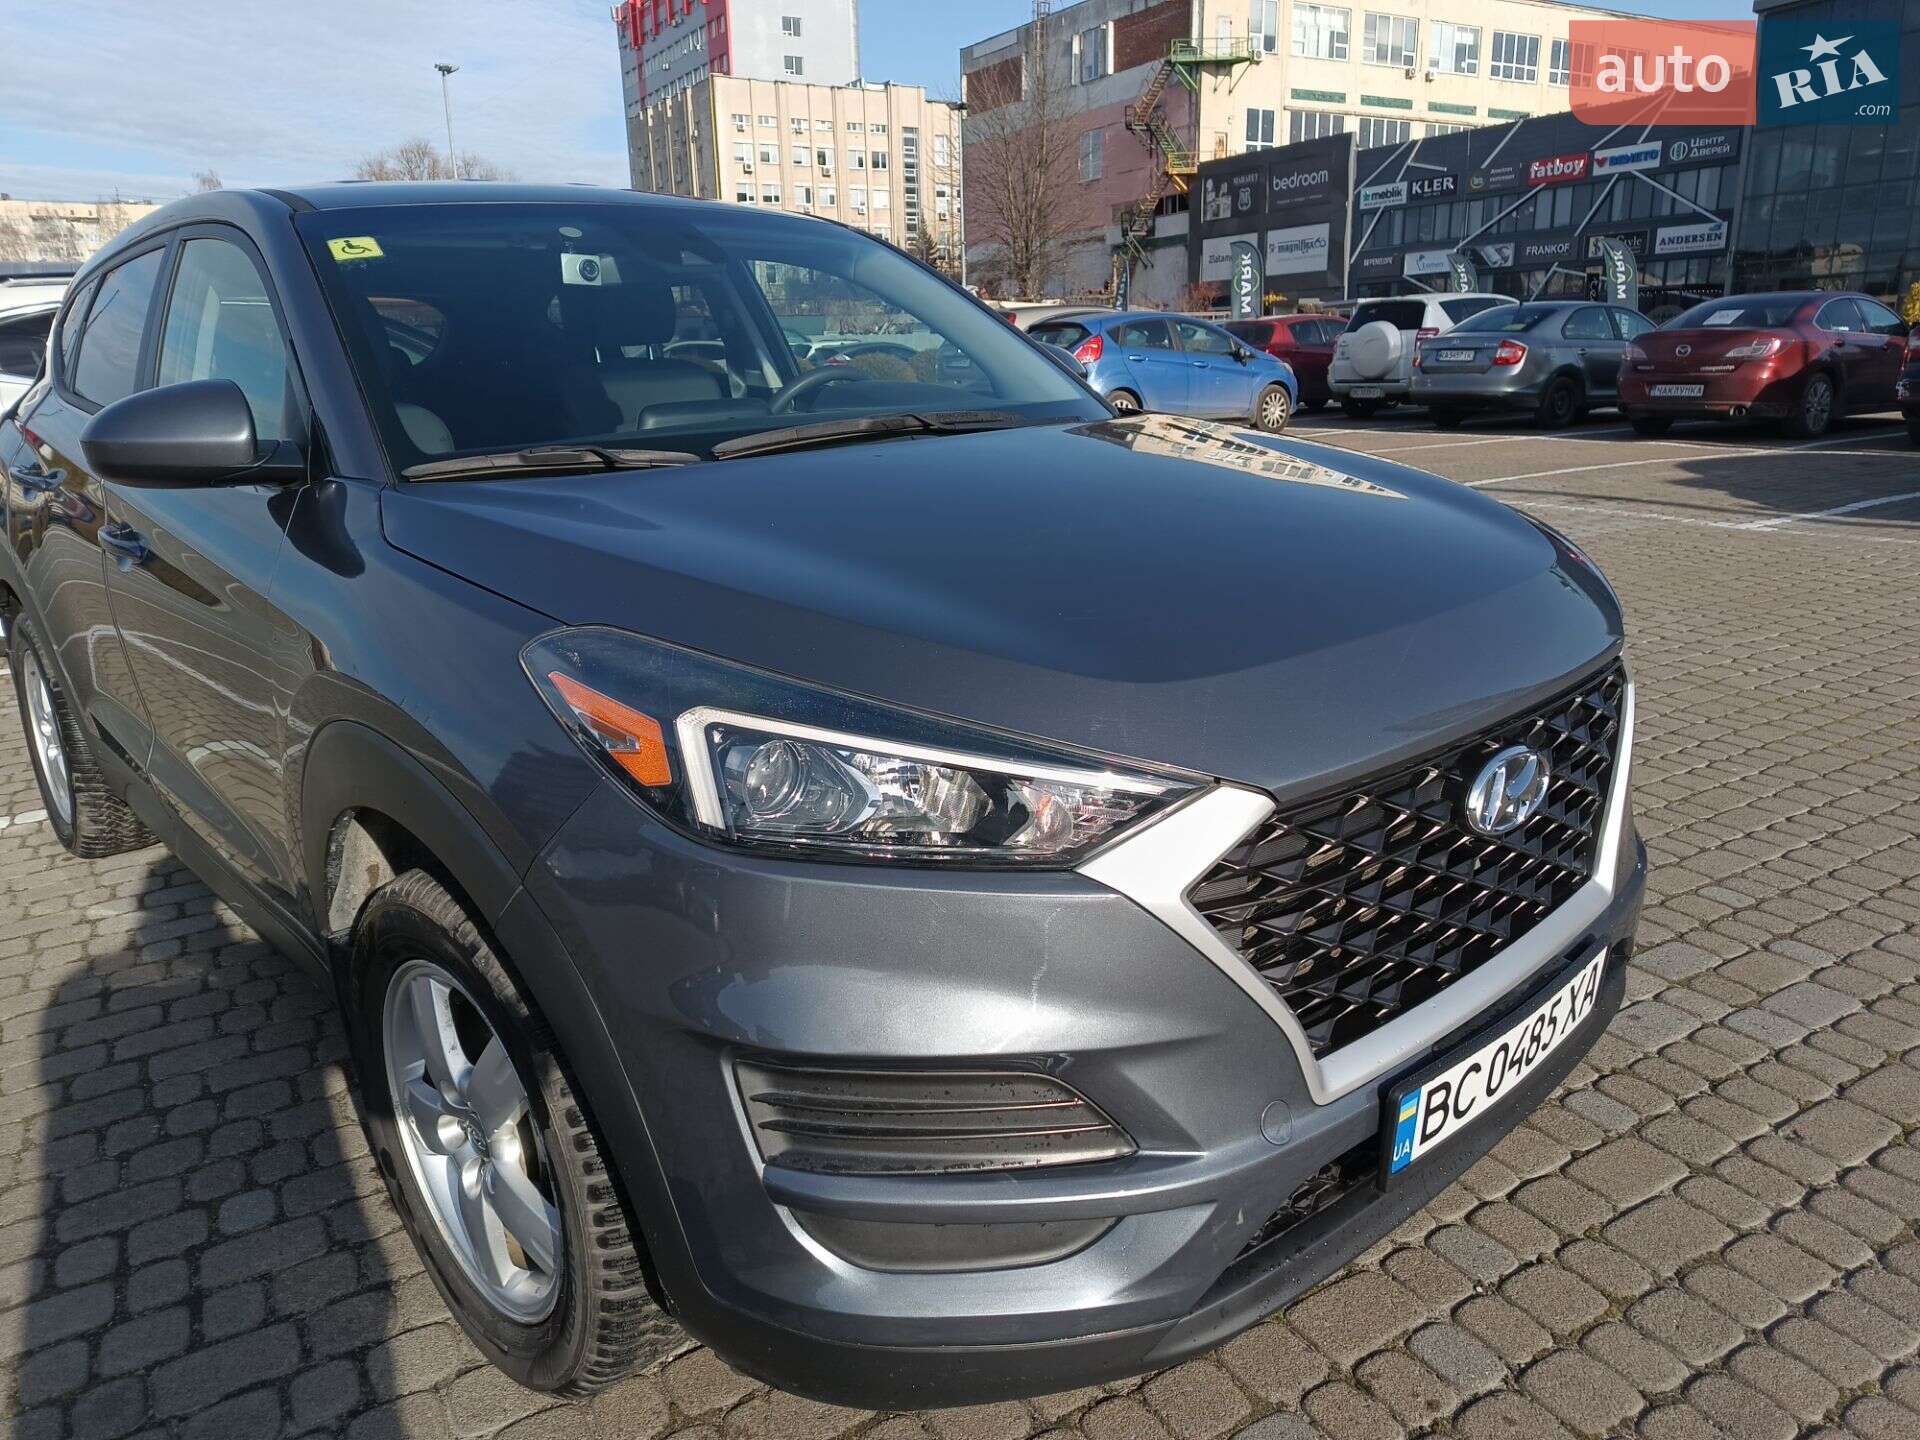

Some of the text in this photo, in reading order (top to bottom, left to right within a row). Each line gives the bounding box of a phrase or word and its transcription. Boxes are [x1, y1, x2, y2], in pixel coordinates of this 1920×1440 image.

[1273, 170, 1329, 191] bedroom
[1412, 176, 1454, 195] KLER
[1659, 232, 1722, 246] ANDERSEN
[1420, 1062, 1482, 1146] BC
[1486, 1000, 1562, 1098] 0485
[1393, 1141, 1411, 1162] UA
